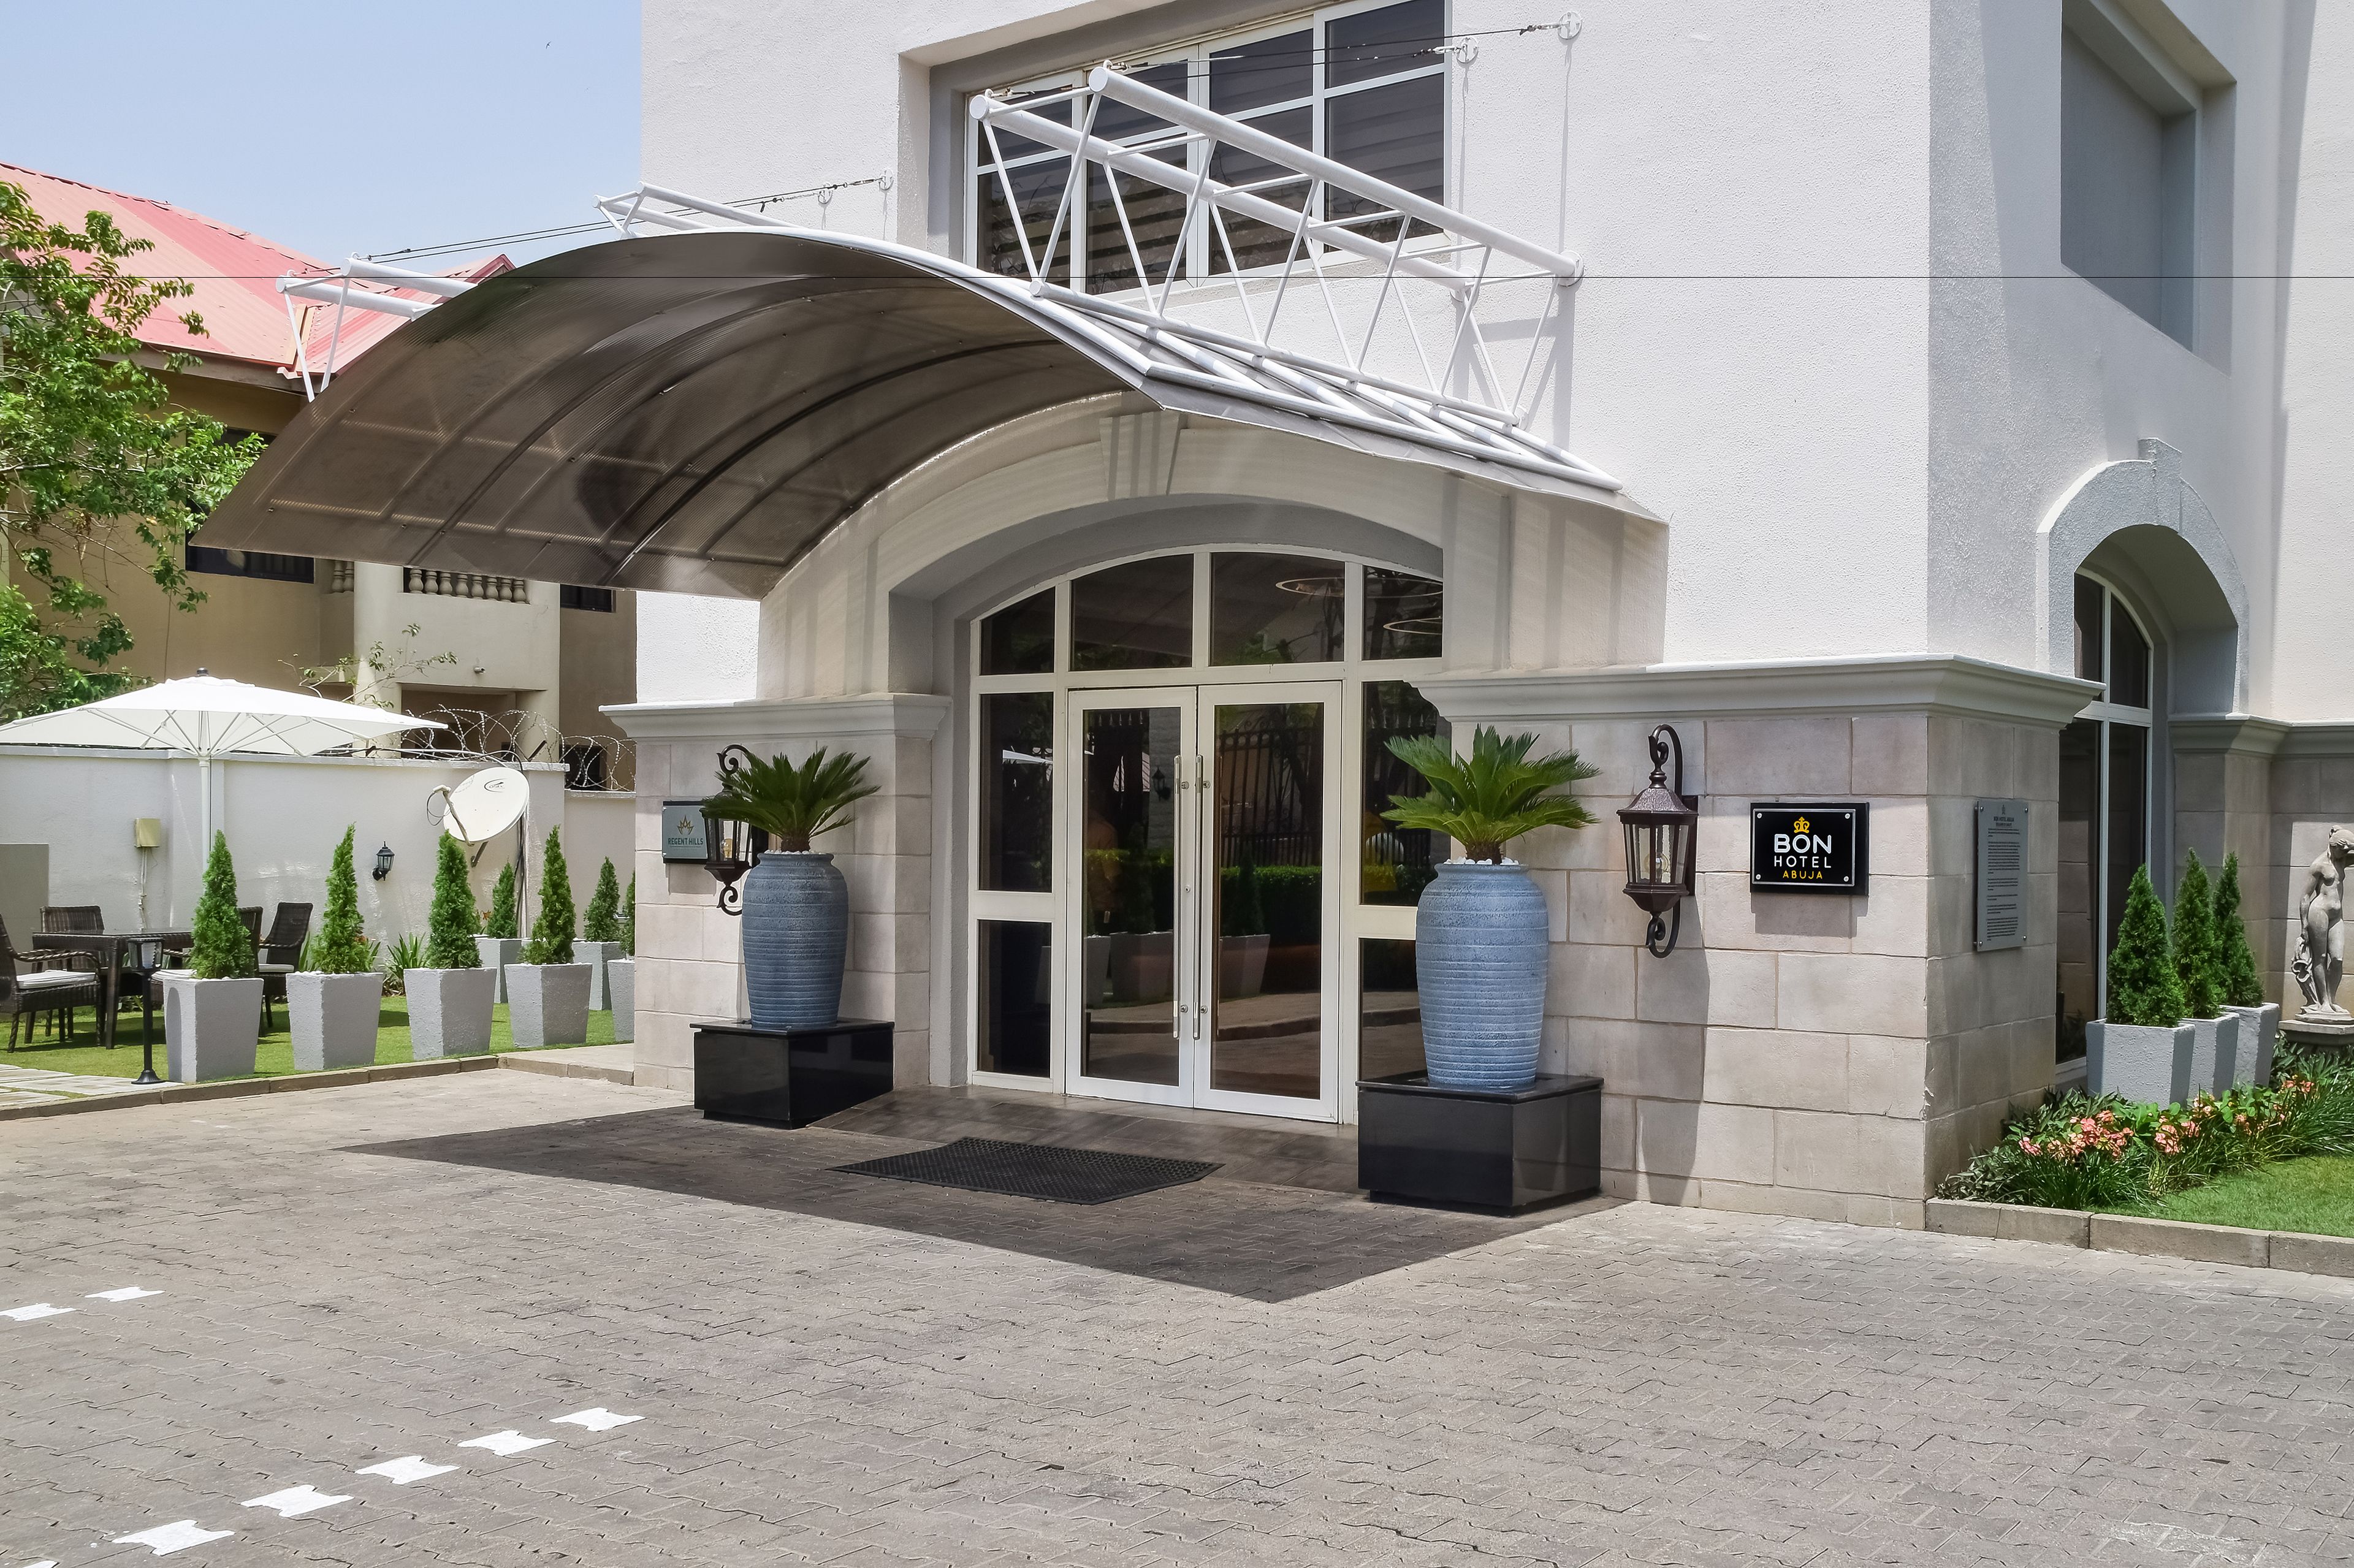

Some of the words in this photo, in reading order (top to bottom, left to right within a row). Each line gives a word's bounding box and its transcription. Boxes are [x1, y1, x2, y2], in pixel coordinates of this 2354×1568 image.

[1774, 834, 1832, 854] BON
[1774, 855, 1832, 869] HOTEL
[1783, 870, 1823, 880] ABUJA
